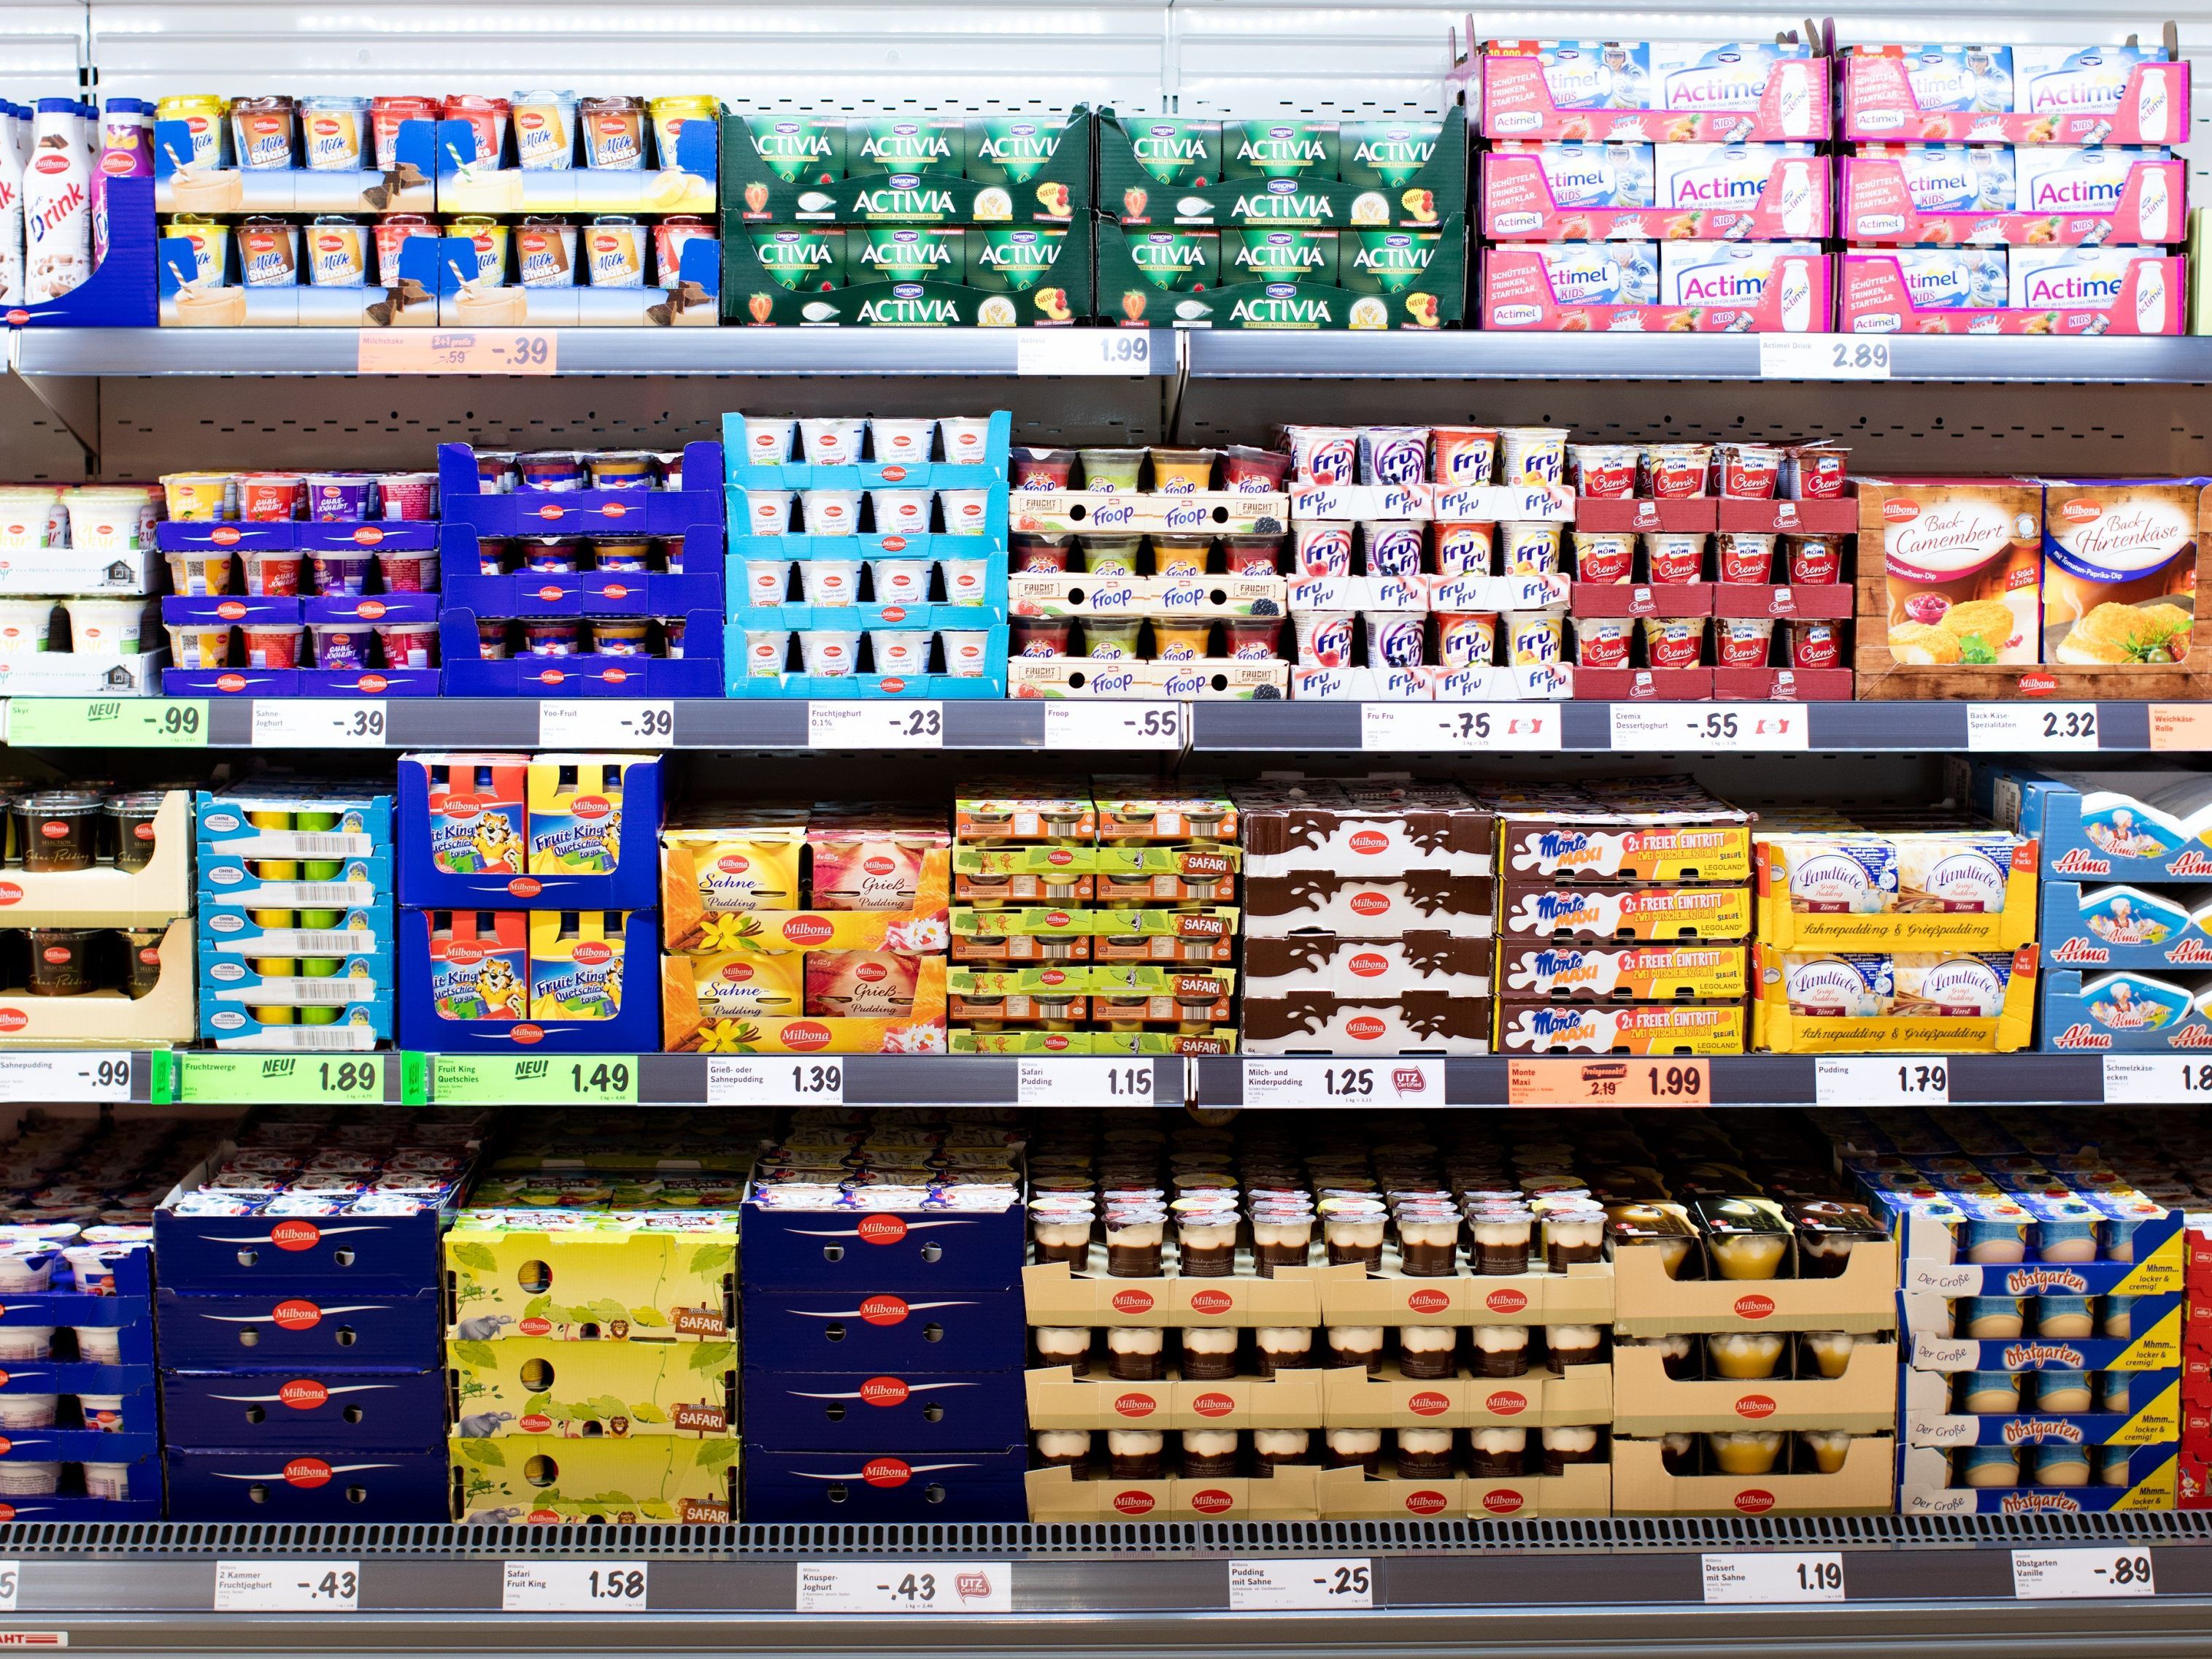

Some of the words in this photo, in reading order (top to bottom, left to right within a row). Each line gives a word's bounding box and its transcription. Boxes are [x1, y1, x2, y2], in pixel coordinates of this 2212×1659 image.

[598, 135, 633, 154] Milk
[597, 147, 637, 165] Shake
[35, 160, 69, 169] Milbona
[1039, 188, 1057, 199] NEU!
[852, 190, 955, 213] ACTIVIA
[1231, 195, 1333, 218] ACTIVIA
[30, 182, 84, 242] Drink
[1492, 265, 1538, 281] SCHÜTTELN,
[1492, 277, 1527, 289] TRINKEN,
[1492, 285, 1537, 300] STARTKLAR.
[1408, 298, 1426, 309] NEU!
[857, 299, 960, 323] ACTIVIA
[1496, 307, 1535, 318] Actimel
[1713, 310, 1735, 323] KIDS
[1101, 337, 1147, 361] 1.99
[1833, 343, 1887, 367] 2.89
[1592, 475, 1630, 493] Cremix
[1026, 499, 1056, 509] FRUCHT
[2062, 505, 2100, 515] Milbona
[1091, 506, 1133, 526] Froop
[1633, 515, 1660, 526] Cremix
[1925, 511, 1964, 534] Back-
[2107, 511, 2146, 533] Back-
[211, 531, 241, 539] Milbona
[1896, 517, 2005, 555] Camembert
[2076, 517, 2178, 554] Hirtenkäse
[12, 707, 29, 715] Skyr
[88, 703, 120, 720] NEU!
[544, 709, 577, 717] Yoo-Fruit
[812, 710, 861, 719] Fruchtjoghurt
[1048, 709, 1069, 718] Froop
[255, 719, 283, 727] Joghurt
[1616, 722, 1668, 731] Dessertjoghurt
[1970, 721, 2016, 729] Spezialitäten
[2043, 712, 2095, 738] 2.32
[572, 801, 610, 811] Milbona
[534, 829, 571, 851] Fruit
[574, 825, 604, 837] King
[1350, 837, 1388, 846] Milbona
[1628, 837, 1640, 850] 2x
[1643, 835, 1676, 850] FREIER
[1679, 832, 1724, 847] EINTRITT
[553, 838, 604, 856] Quetschies
[1539, 832, 1588, 858] Monte
[1188, 857, 1227, 870] SAFARI
[1557, 847, 1602, 867] MAXI
[2054, 850, 2108, 874] Alma
[699, 874, 765, 889] Sahne-
[1800, 866, 1862, 890] Landliebe
[511, 883, 542, 891] Milbona
[862, 877, 911, 895] Grieß-
[708, 896, 757, 909] Pudding
[860, 897, 905, 909] Pudding
[785, 923, 831, 935] Milbona
[1803, 923, 1889, 936] Sahnepudding
[1894, 924, 1901, 935] &
[1907, 923, 1989, 936] Grießpudding
[1, 1061, 53, 1069] Sahnepudding
[185, 1063, 236, 1071] Fruchtzwerge
[262, 1058, 296, 1074] NEU!
[458, 1066, 476, 1074] King
[515, 1061, 548, 1077] NEU!
[1819, 1066, 1849, 1074] Pudding
[320, 1063, 375, 1090] 1.89
[438, 1075, 479, 1083] Quetschies
[572, 1063, 628, 1093] 1.49
[711, 1076, 763, 1084] Sahnepudding
[793, 1066, 841, 1093] 1.39
[1022, 1078, 1052, 1086] Pudding
[1108, 1069, 1152, 1095] 1.15
[1249, 1078, 1303, 1087] Kinderpudding
[1324, 1069, 1373, 1095] 1.25
[1397, 1072, 1418, 1083] UTZ
[1649, 1067, 1700, 1095] 1.99
[1898, 1066, 1946, 1092] 1.79
[1591, 1082, 1616, 1095] 2.19
[274, 1229, 316, 1239] Milbona
[860, 1224, 903, 1233] Milbona
[1918, 1271, 1938, 1284] Der
[1939, 1272, 1970, 1287] Große
[2008, 1267, 2084, 1293] Obstgarten
[2129, 1282, 2157, 1291] cremig!
[1114, 1296, 1152, 1306] Milbona
[1735, 1301, 1773, 1312] Milbona
[520, 1322, 550, 1331] Milbona
[680, 1316, 722, 1332] SAFARI
[2016, 1560, 2057, 1568] Obstgarten
[803, 1574, 838, 1582] Knusper-
[1232, 1568, 1264, 1577] Pudding
[1797, 1563, 1842, 1590] 1.19
[219, 1581, 272, 1590] Fruchtjoghurt
[528, 1580, 546, 1589] King
[590, 1571, 644, 1598] 1.58
[803, 1583, 832, 1592] Joghurt
[960, 1577, 983, 1588] UTZ
